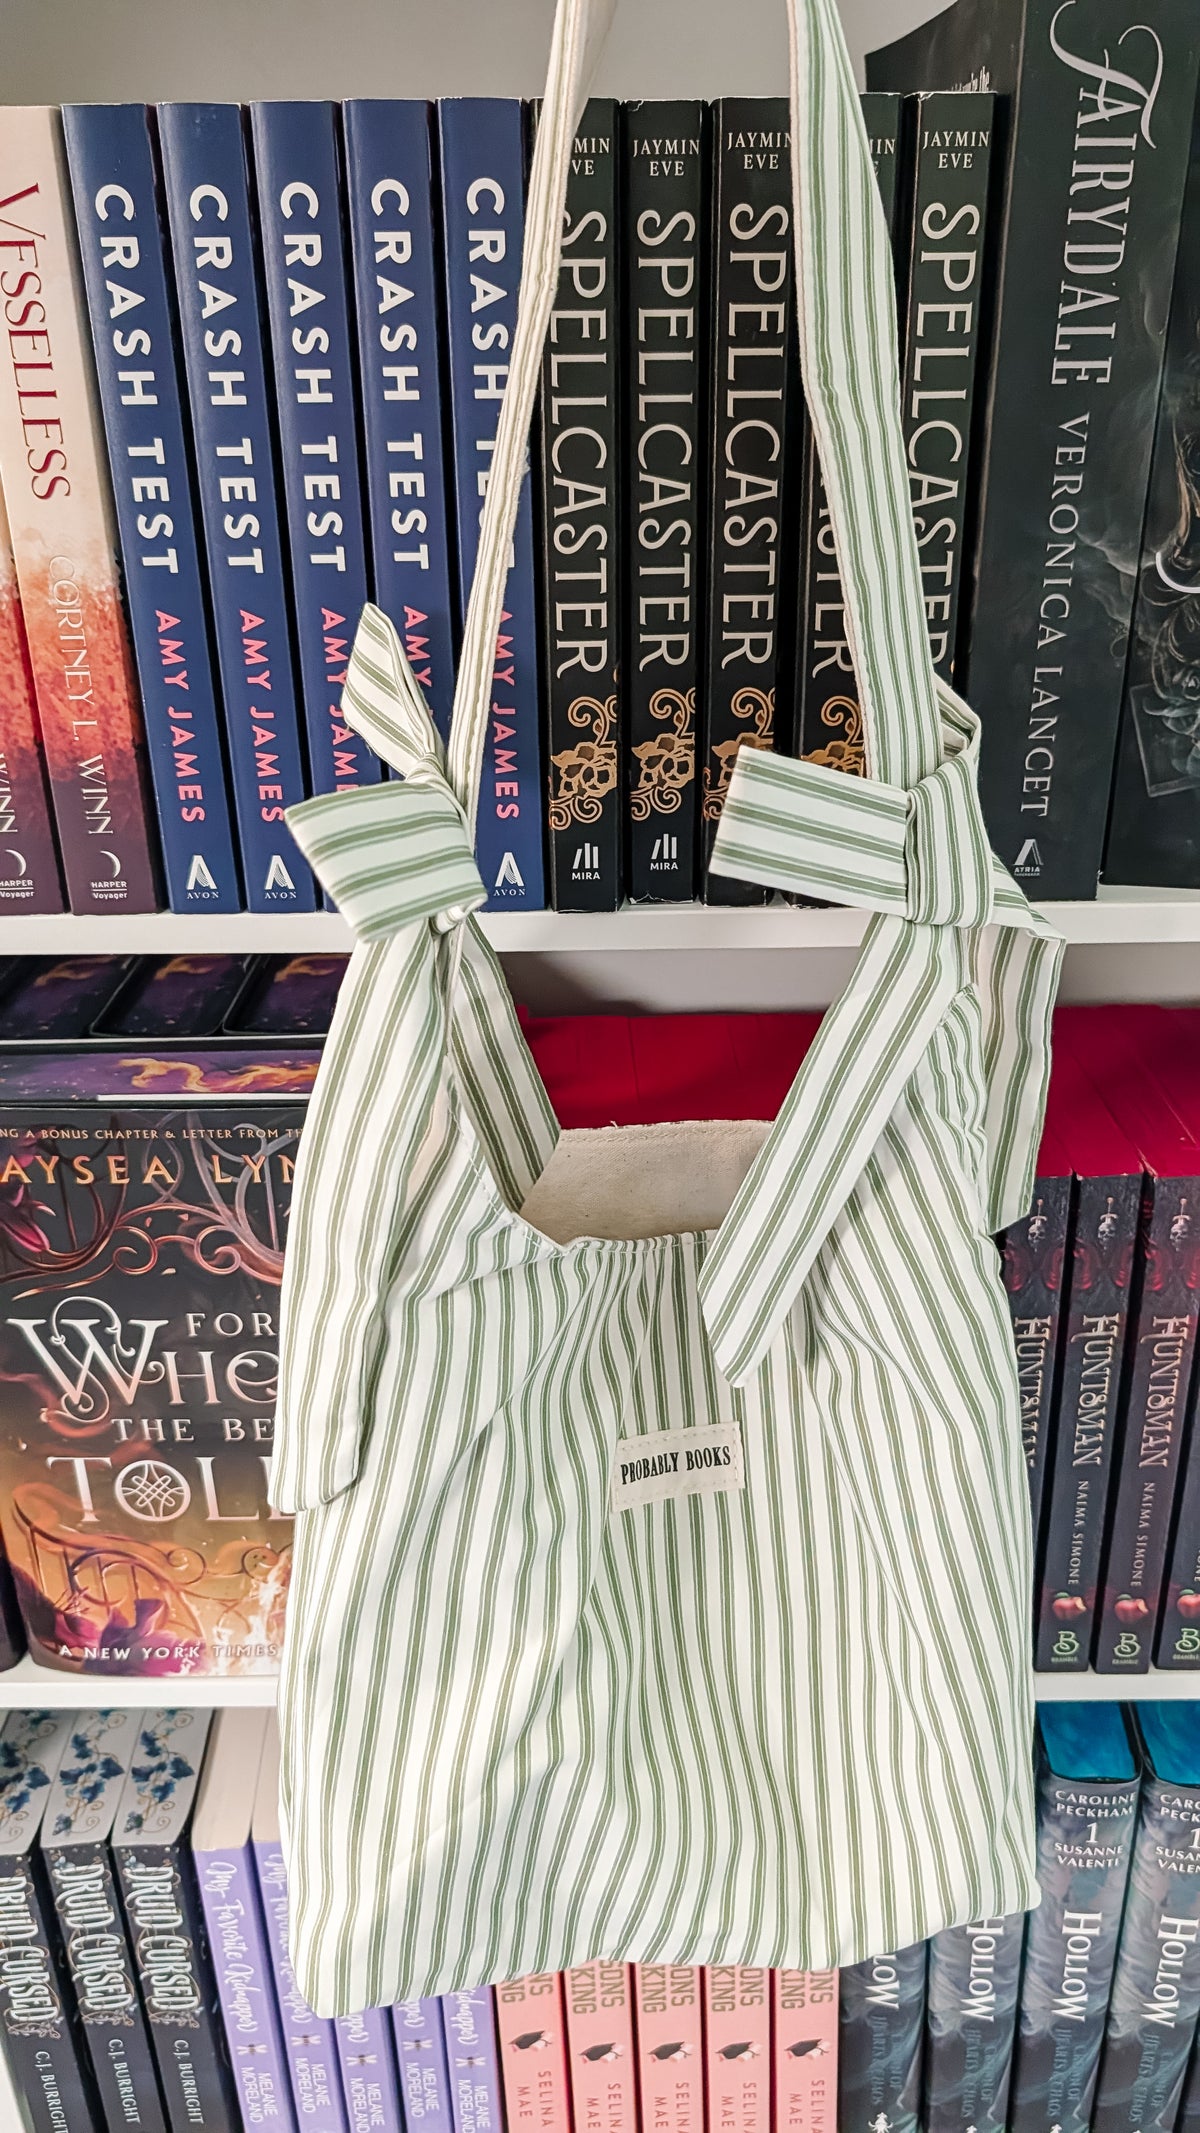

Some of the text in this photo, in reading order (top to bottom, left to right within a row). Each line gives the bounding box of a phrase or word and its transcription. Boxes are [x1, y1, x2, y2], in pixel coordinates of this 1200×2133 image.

[574, 137, 610, 154] MIN
[633, 138, 699, 157] JAYMIN
[728, 132, 792, 151] JAYMIN
[743, 154, 779, 170] EVE
[923, 131, 990, 150] JAYMIN
[938, 153, 973, 168] EVE
[571, 159, 595, 175] VE
[650, 161, 684, 176] EVE
[1049, 0, 1163, 386] FAIRYDALE
[466, 178, 509, 400] CRASH
[0, 182, 71, 500] VESSELLESS
[95, 184, 179, 573] CRASH TEST
[190, 184, 263, 573] CRASH TEST
[280, 182, 346, 572] CRASH TEST
[371, 178, 429, 570] CRASH TEST
[551, 210, 608, 679] SPELLCASTER
[637, 209, 695, 672] SPELLCASTER
[721, 202, 789, 670] SPELLCASTER
[1036, 412, 1090, 650] VERONICA
[404, 606, 432, 687] AMY
[50, 556, 113, 835] CORTNEY L. WINN
[156, 610, 206, 822] AMY JAMES
[240, 610, 285, 822] AMY JAMES
[492, 702, 520, 819] JAMES
[1020, 666, 1063, 817] LANCET
[91, 880, 127, 889] HARPER
[572, 872, 600, 880] MIRA
[650, 862, 678, 870] MIRA
[92, 890, 127, 900] Voyager
[186, 891, 219, 899] AVON
[264, 891, 296, 899] AVON
[26, 1129, 35, 1139] A
[41, 1129, 89, 1140] BONUS
[95, 1129, 158, 1140] CHAPTER
[166, 1130, 175, 1138] &
[183, 1128, 233, 1138] LETTER
[239, 1128, 279, 1138] FROM
[285, 1128, 303, 1138] TH
[0, 1154, 295, 1184] AYSEA LYN
[186, 1312, 276, 1338] FOR
[111, 1418, 195, 1442] THE
[1067, 1313, 1120, 1585] HUNTSMAN NAIMA SIMONE
[1130, 1314, 1190, 1587] HUNTSMAN NAIMA SIMONE
[620, 1446, 731, 1485] PROBABLY BOOKS
[60, 1644, 277, 1660] A NEW YORK TIMES
[1055, 1790, 1136, 1806] CAROLINE
[1056, 1804, 1133, 1818] PECKHAM
[1160, 1807, 1200, 1823] PECK
[1055, 1843, 1123, 1856] SUSANNE
[1086, 1822, 1098, 1844] 1
[1057, 1855, 1119, 1868] VALENTI
[55, 1864, 132, 2010] DRUID CURSED
[125, 1865, 199, 2012] DRUID CURSED
[205, 1861, 261, 2032] My Favorite Kidnapper
[0, 1945, 58, 2021] CURSED
[711, 1966, 736, 2013] KING
[781, 1969, 805, 2010] KING
[865, 1953, 900, 2010] LOW
[960, 1915, 1004, 2022] HOLLOW
[1051, 1909, 1102, 2023] HOLLOW
[1140, 1913, 1200, 2029] HOLLOW
[571, 1966, 597, 2014] KING
[641, 1966, 667, 2014] KING
[450, 1989, 486, 2045] idnapper
[35, 2051, 52, 2071] C.J.
[108, 2039, 141, 2125] C.J. BURRIGHT
[172, 2039, 204, 2125] C.J. BURRIGHT
[311, 2063, 331, 2106] MELANIE
[241, 2067, 264, 2123] MORELAND
[258, 2072, 278, 2116] MELANIE
[294, 2057, 316, 2113] MORELAND
[350, 2077, 370, 2133] MORELAND
[367, 2083, 385, 2126] MELANIE
[406, 2062, 425, 2118] MORELAND
[422, 2068, 440, 2111] MELANIE
[458, 2079, 475, 2133] MORELAND
[475, 2085, 491, 2128] MELANIE
[517, 2086, 532, 2117] MAE
[538, 2071, 553, 2127] SELINA
[587, 2098, 600, 2129] MAE
[654, 2097, 668, 2128] MAE
[721, 2096, 735, 2127] MAE
[789, 2093, 802, 2125] MAE
